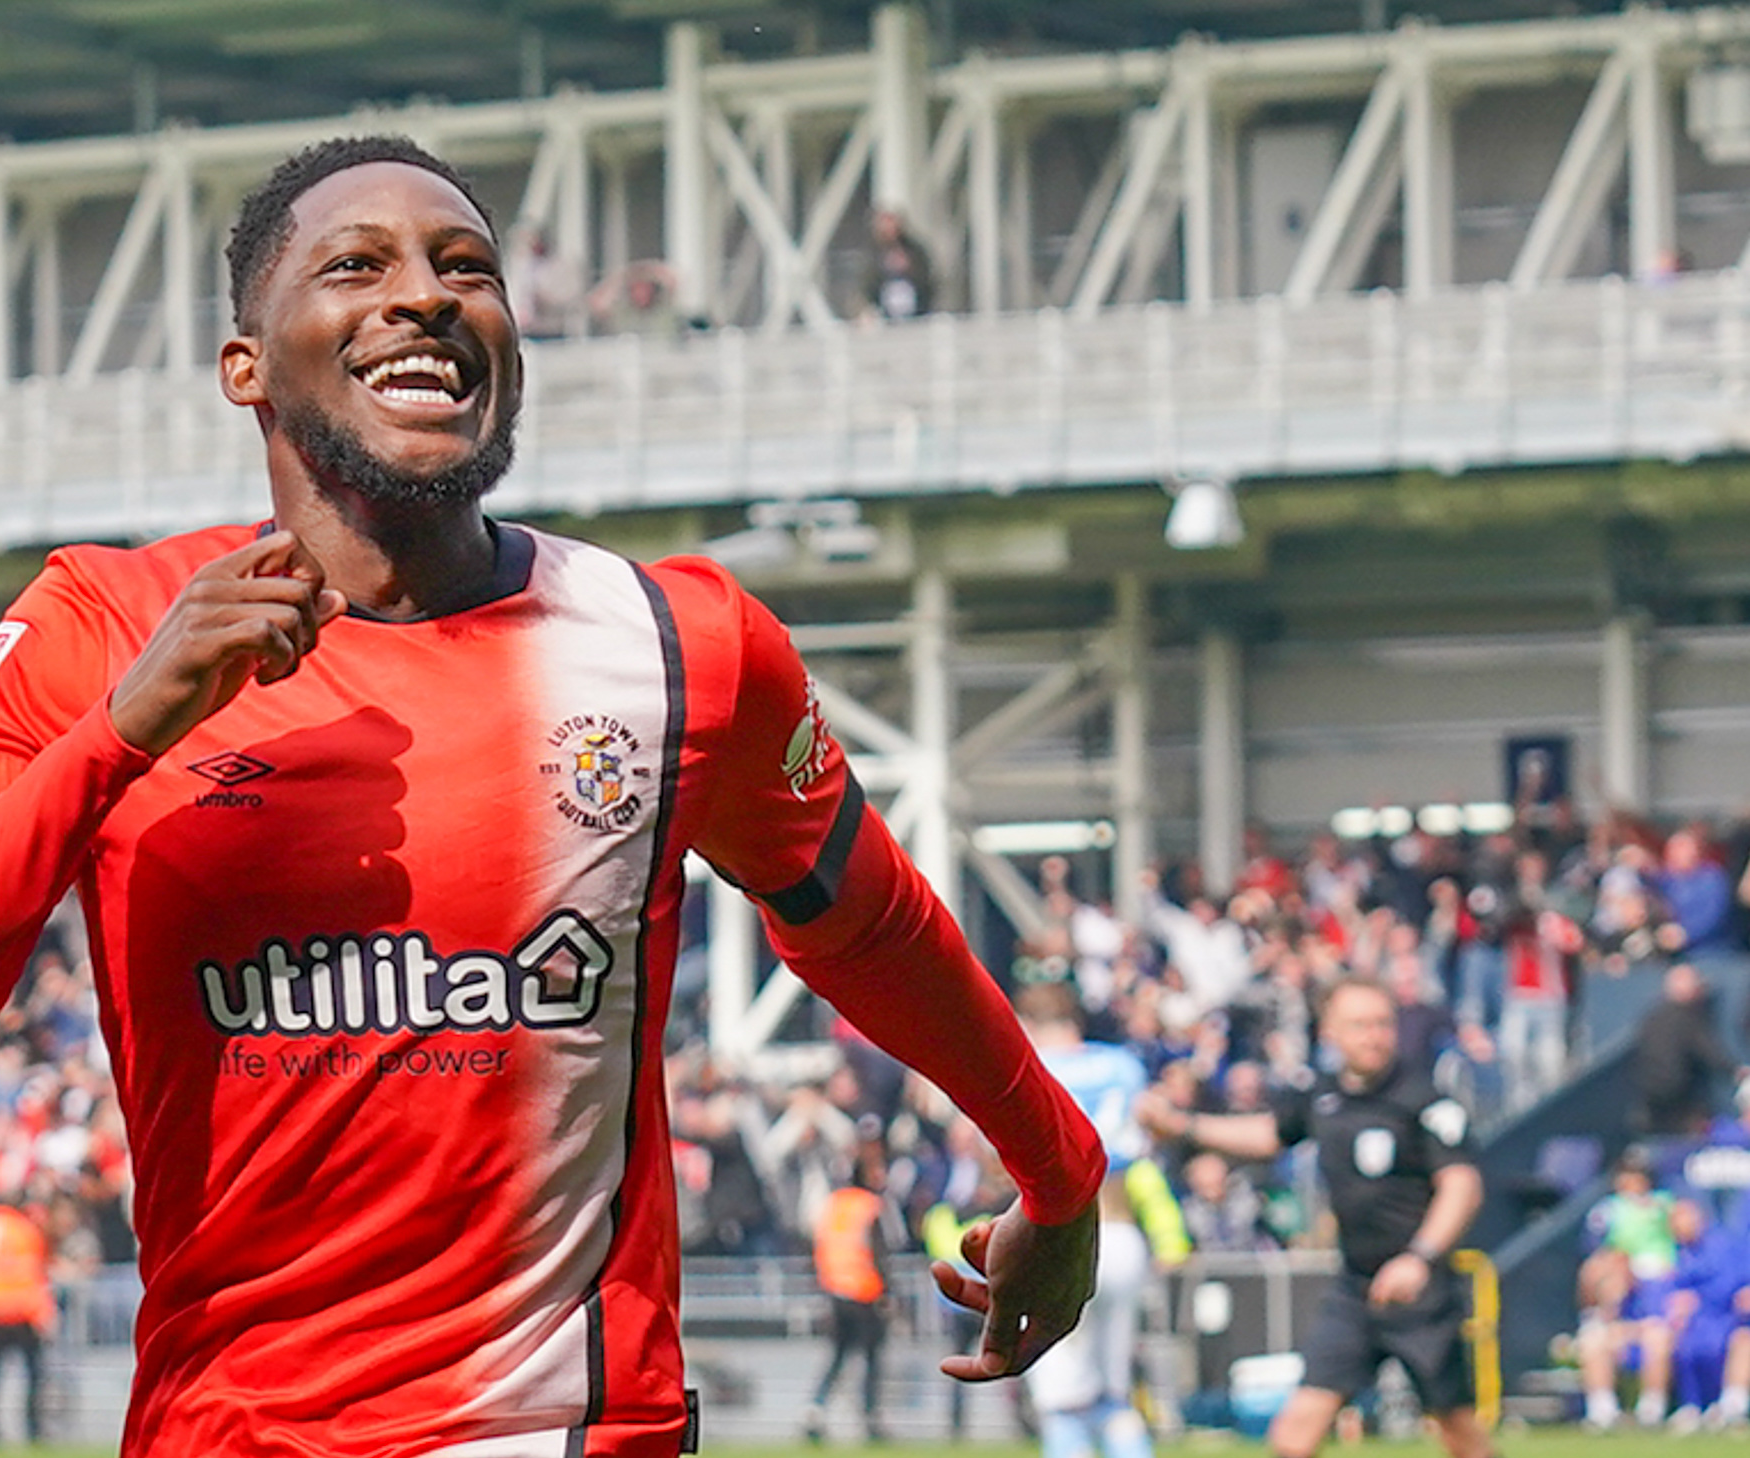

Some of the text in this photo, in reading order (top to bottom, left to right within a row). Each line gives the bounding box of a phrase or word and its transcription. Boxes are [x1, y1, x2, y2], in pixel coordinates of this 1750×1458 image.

[547, 714, 641, 753] LUTON TOWN
[195, 791, 263, 808] umbro
[199, 934, 513, 1031] utilita
[218, 1043, 511, 1079] life with power
